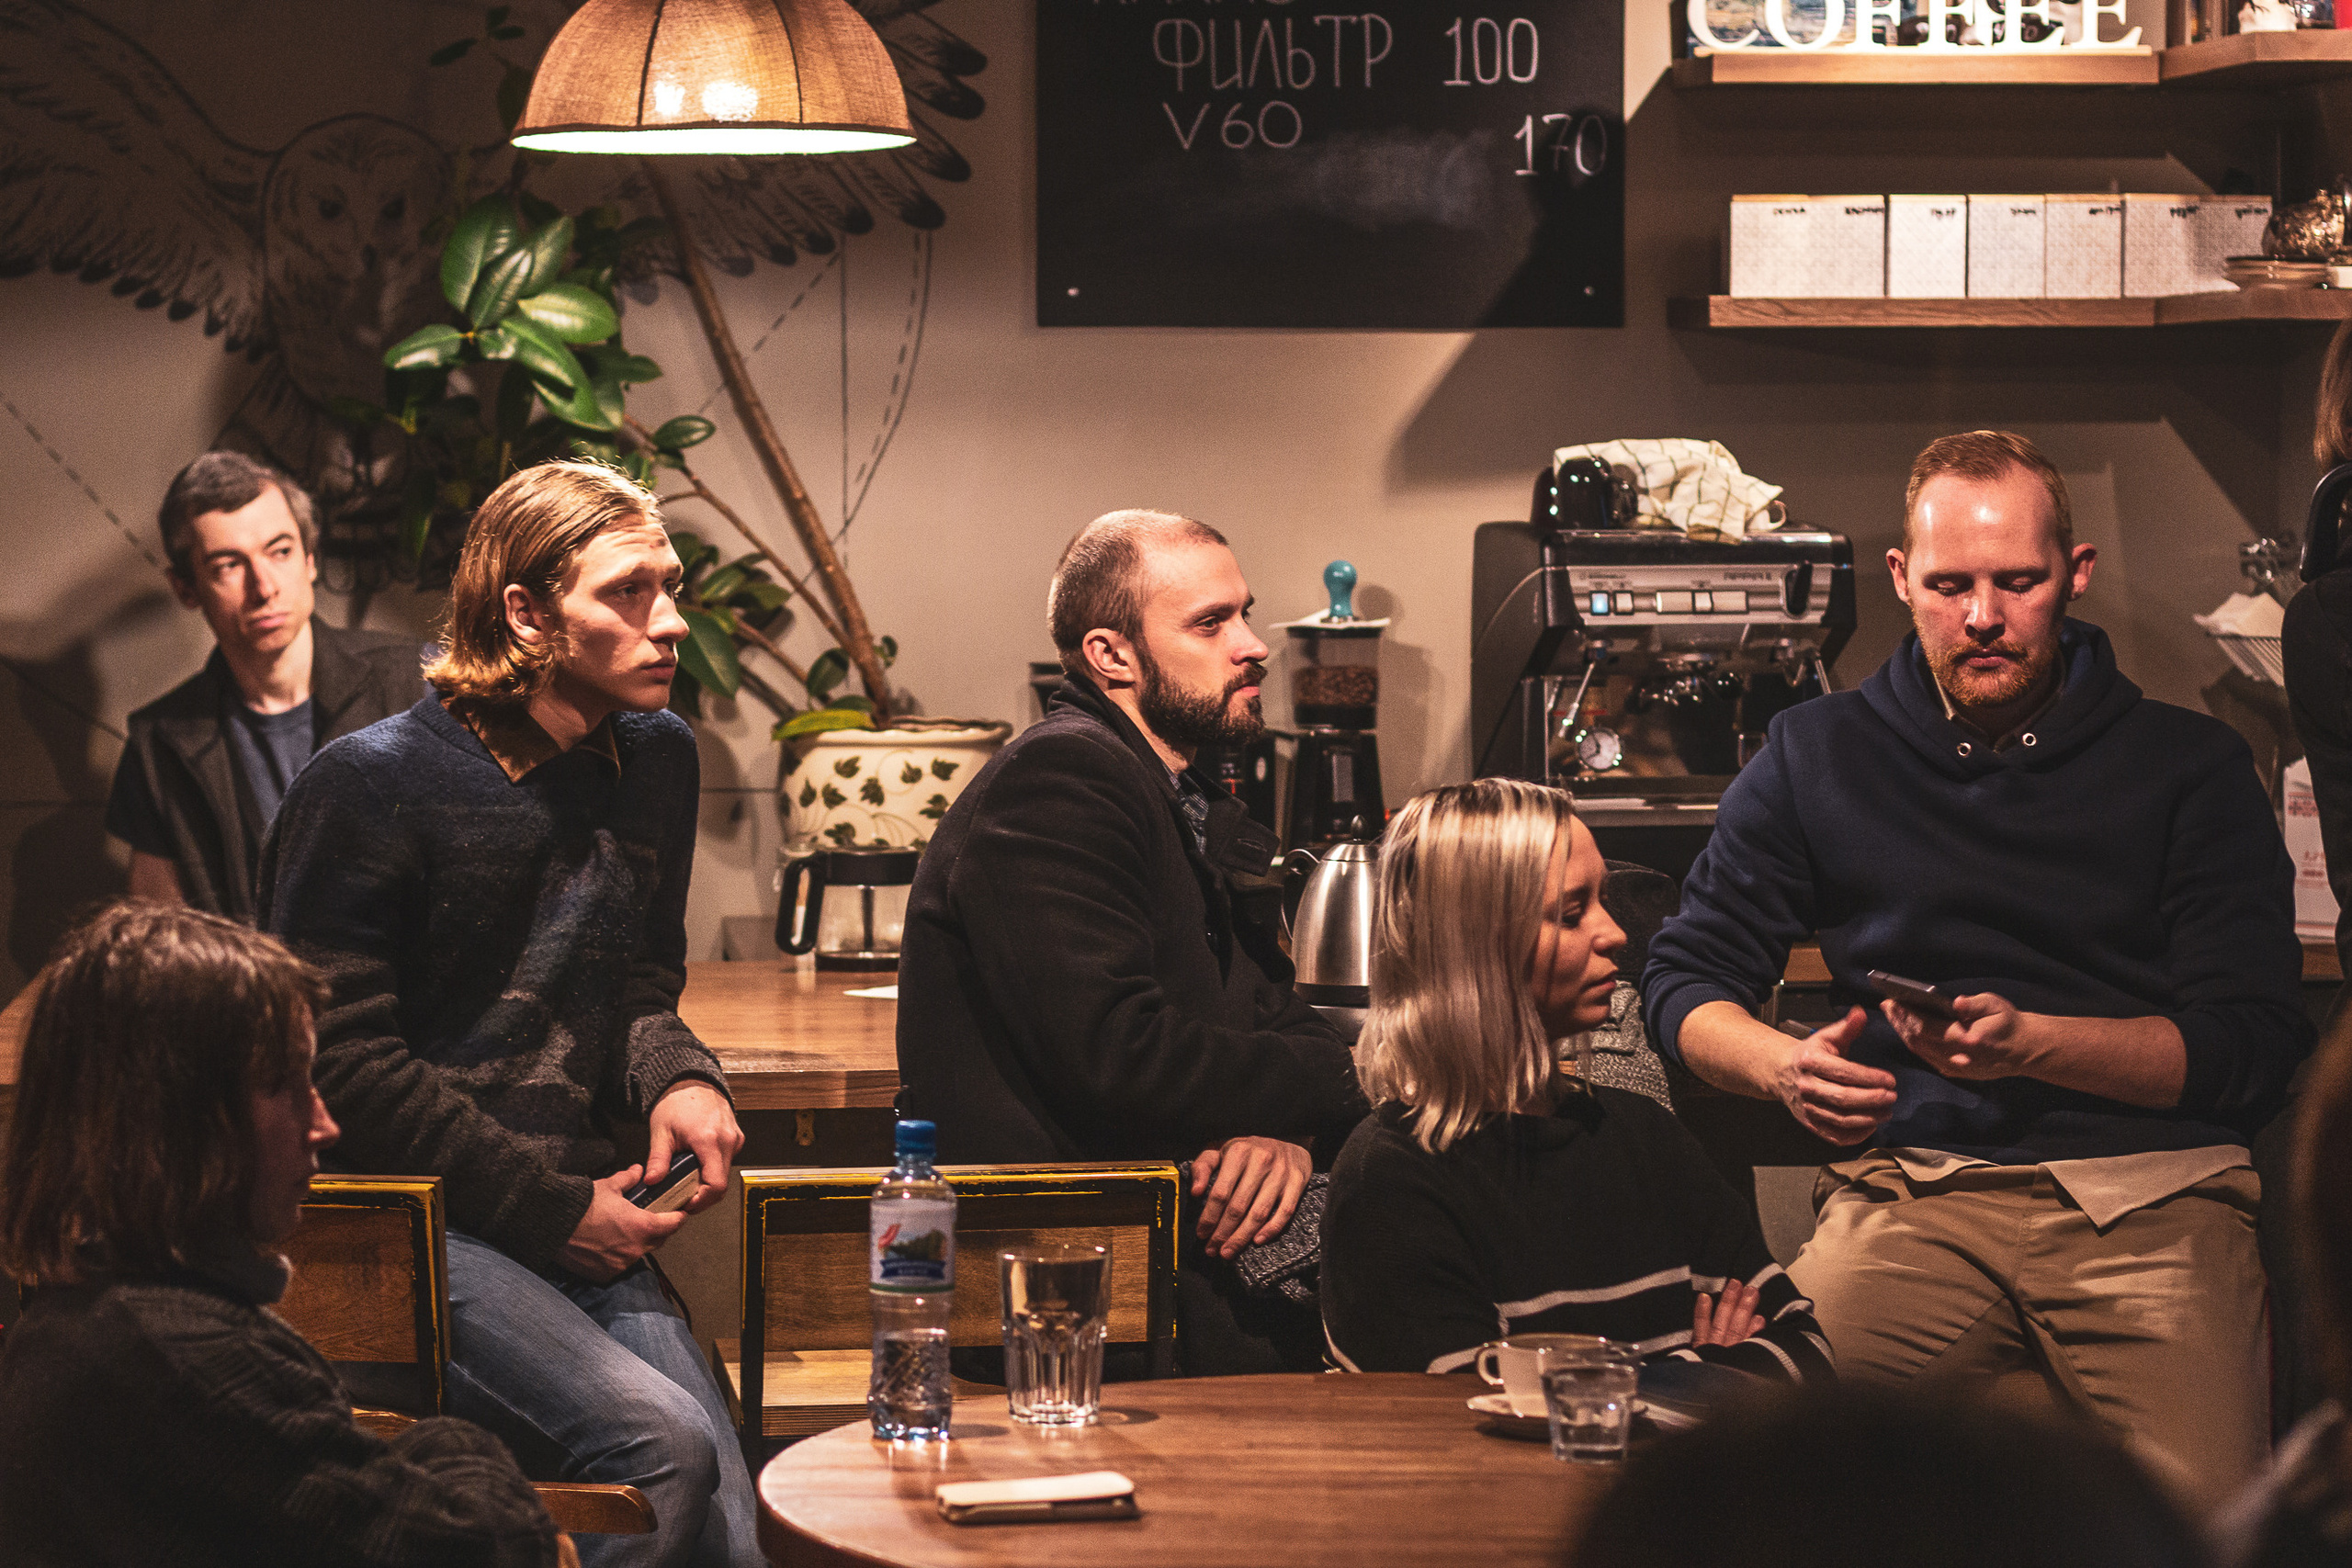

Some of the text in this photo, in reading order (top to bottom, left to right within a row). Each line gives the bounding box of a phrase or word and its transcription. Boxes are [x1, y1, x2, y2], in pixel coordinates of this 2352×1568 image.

[1152, 13, 1539, 91] ФИЛЬТР 100
[1687, 0, 2143, 49] COFFEE
[1513, 113, 1608, 175] 170
